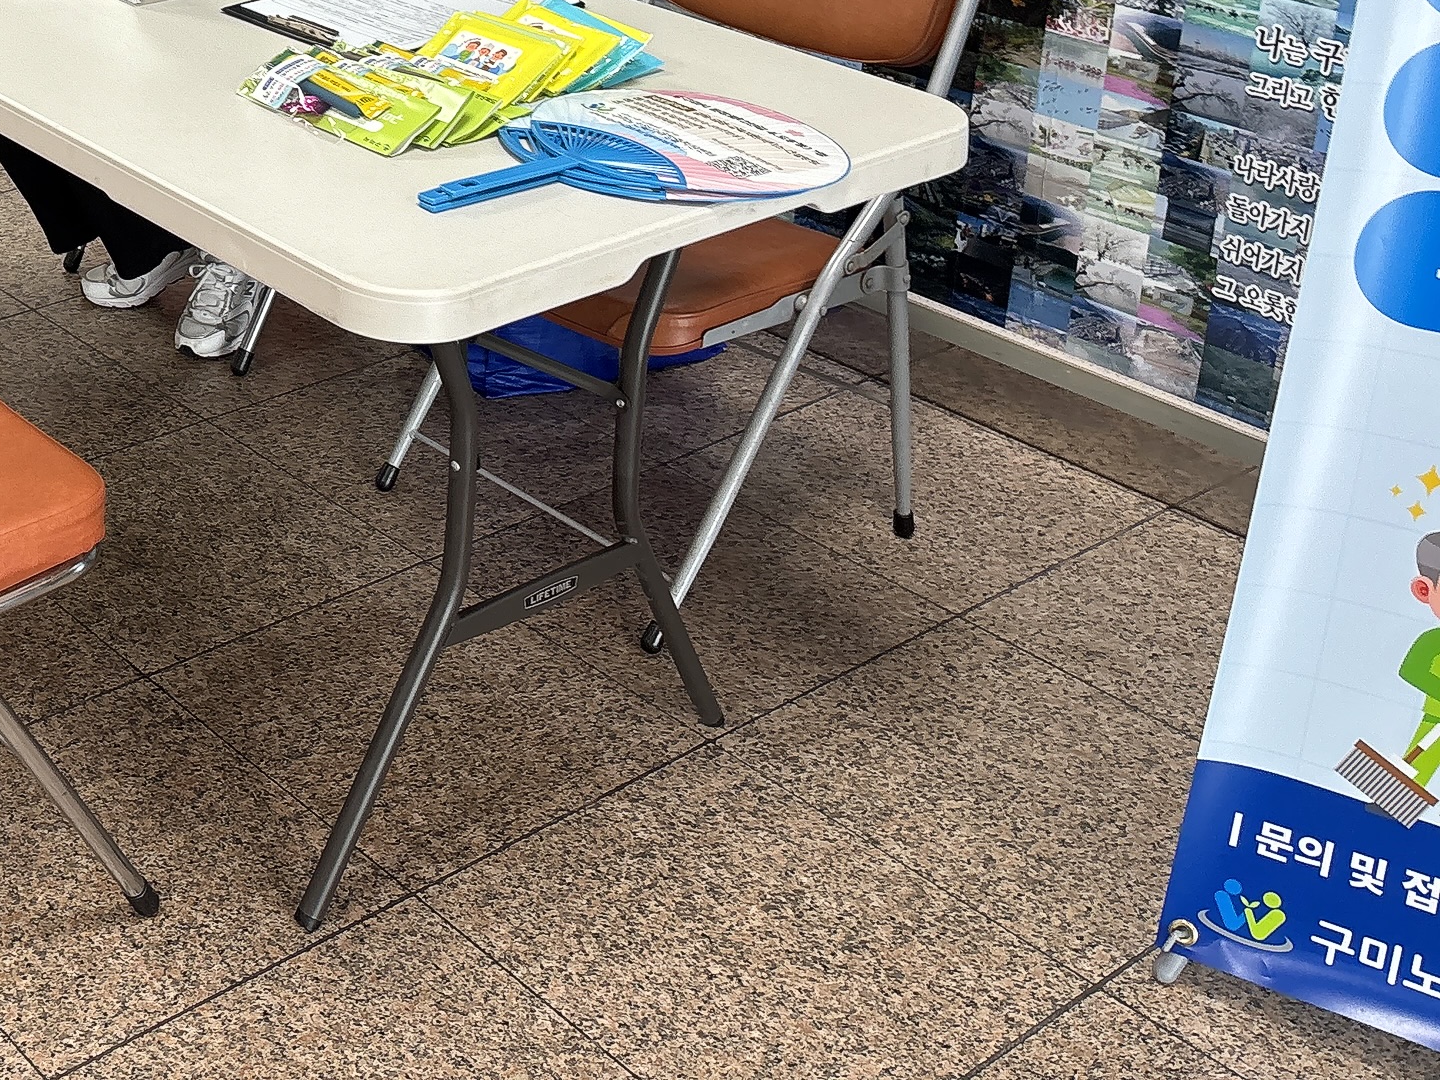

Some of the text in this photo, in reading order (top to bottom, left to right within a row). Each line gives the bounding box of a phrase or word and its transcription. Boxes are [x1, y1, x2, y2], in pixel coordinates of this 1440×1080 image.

[1255, 24, 1308, 66] 나는
[1246, 72, 1314, 111] 그리고
[1233, 154, 1320, 203] 나라사랑
[1226, 192, 1313, 246] 돌아가지
[1212, 274, 1239, 302] 그
[530, 580, 572, 604] LIFETIME
[1256, 821, 1440, 915] 문의 및 접
[1310, 920, 1440, 1000] 구미노
